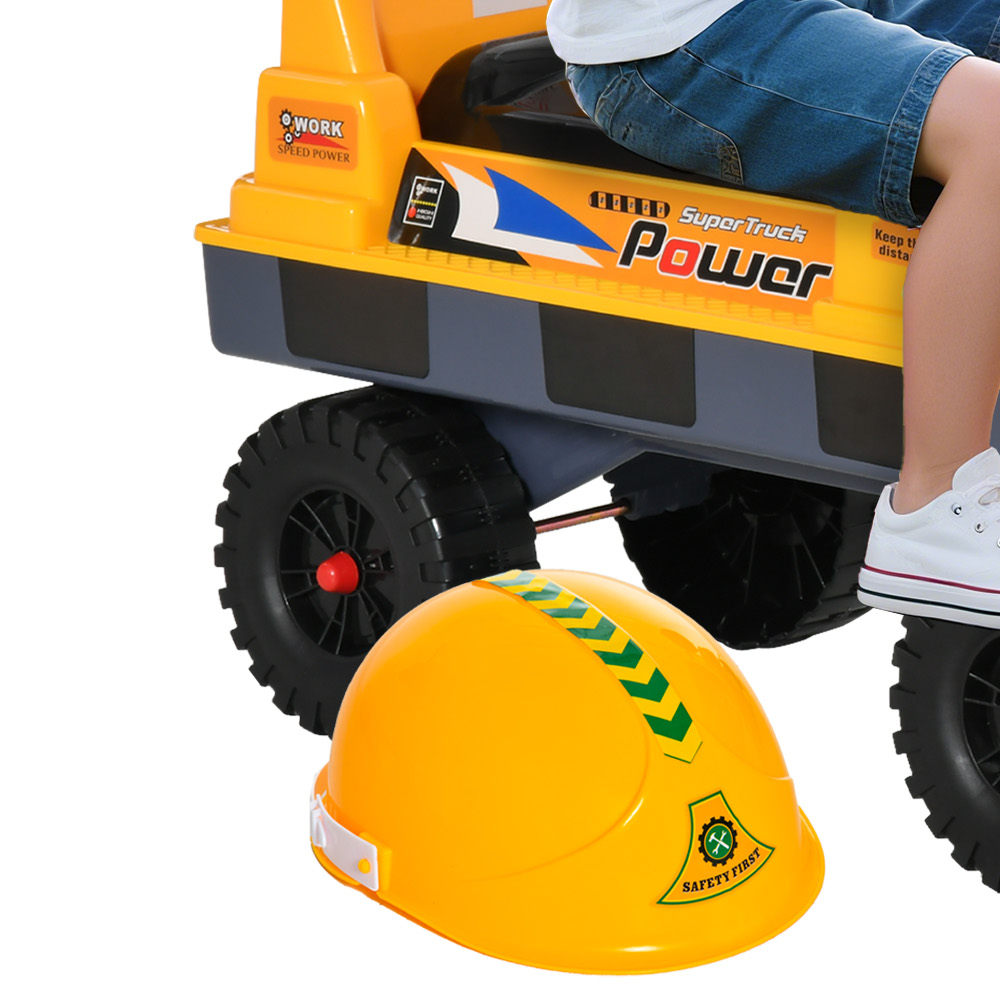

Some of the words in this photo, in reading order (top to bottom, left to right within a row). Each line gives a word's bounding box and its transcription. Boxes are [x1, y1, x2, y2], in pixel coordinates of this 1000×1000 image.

[293, 115, 344, 138] WORK
[277, 144, 310, 158] SPEED
[313, 148, 351, 163] POWER
[875, 229, 904, 247] Keep
[616, 218, 834, 301] Power
[879, 245, 911, 261] dista
[682, 871, 730, 893] SAFETY
[731, 847, 761, 878] FIRST
